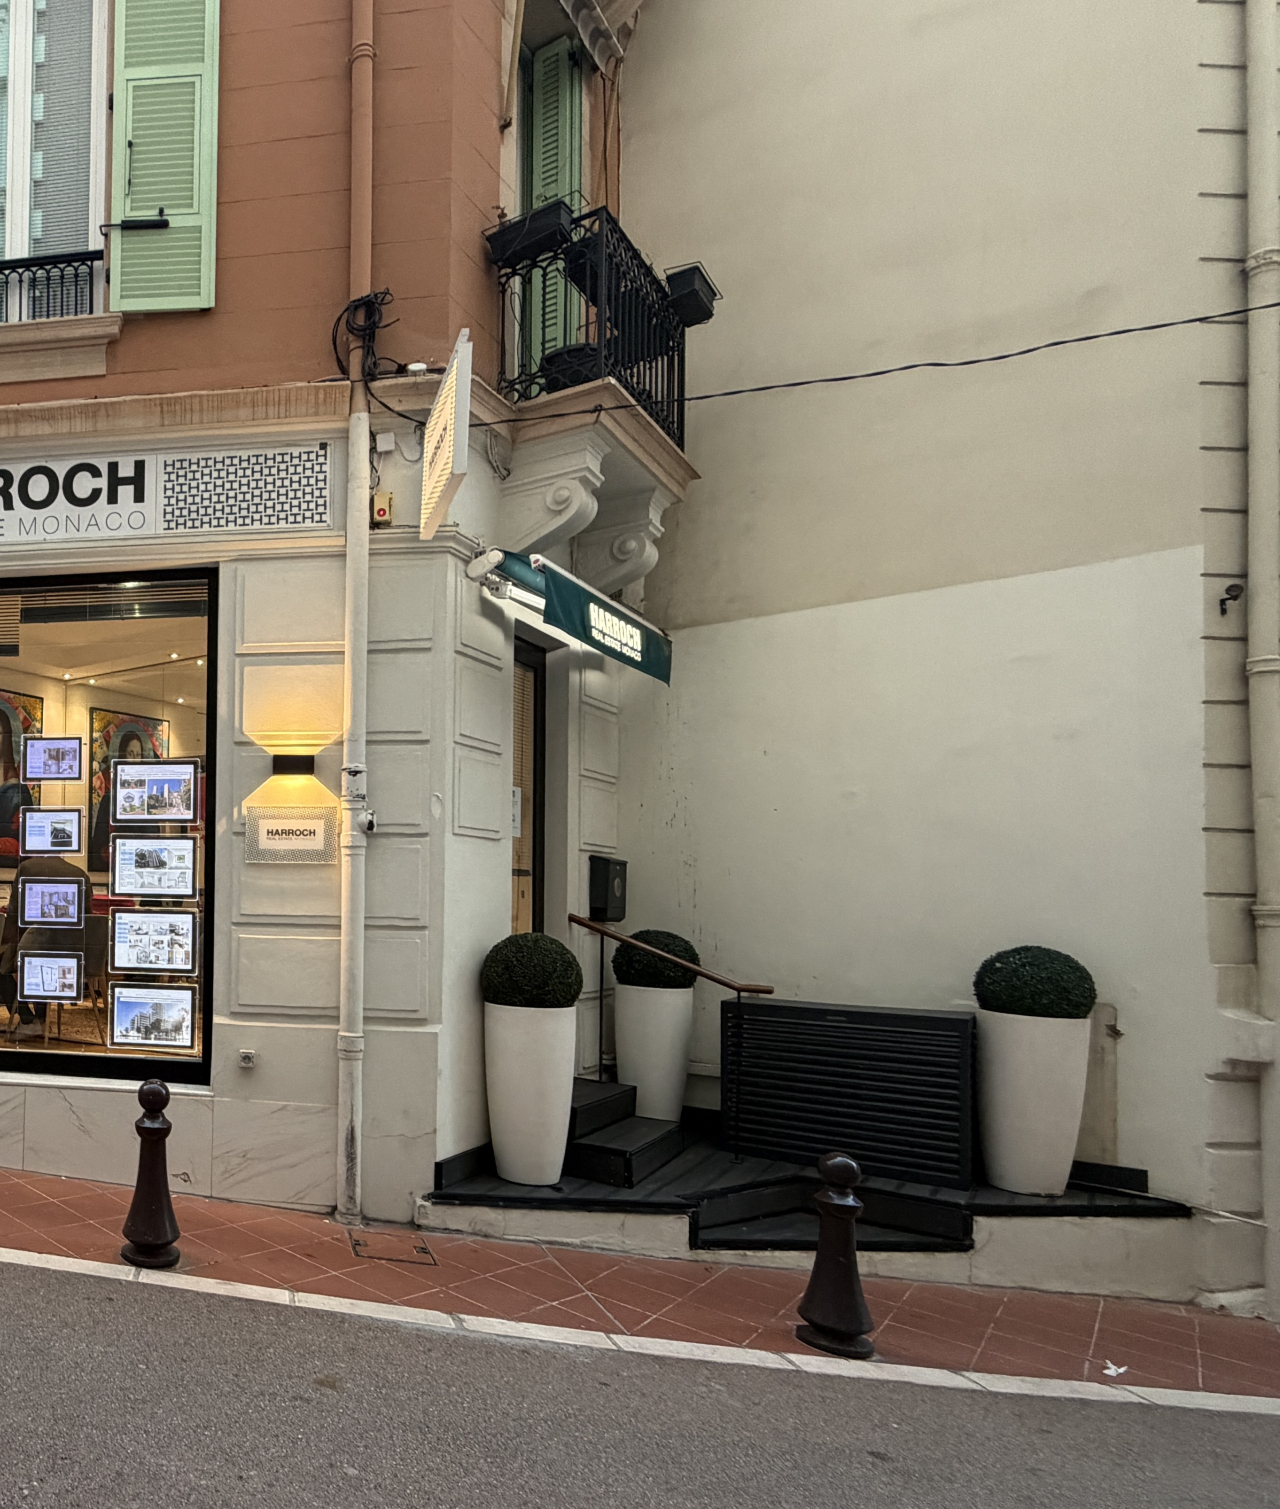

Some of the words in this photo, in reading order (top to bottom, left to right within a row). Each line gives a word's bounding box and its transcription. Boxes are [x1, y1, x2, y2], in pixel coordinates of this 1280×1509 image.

[18, 510, 146, 536] MONACO
[589, 602, 642, 652] HARROCH
[266, 828, 316, 837] HARROCH
